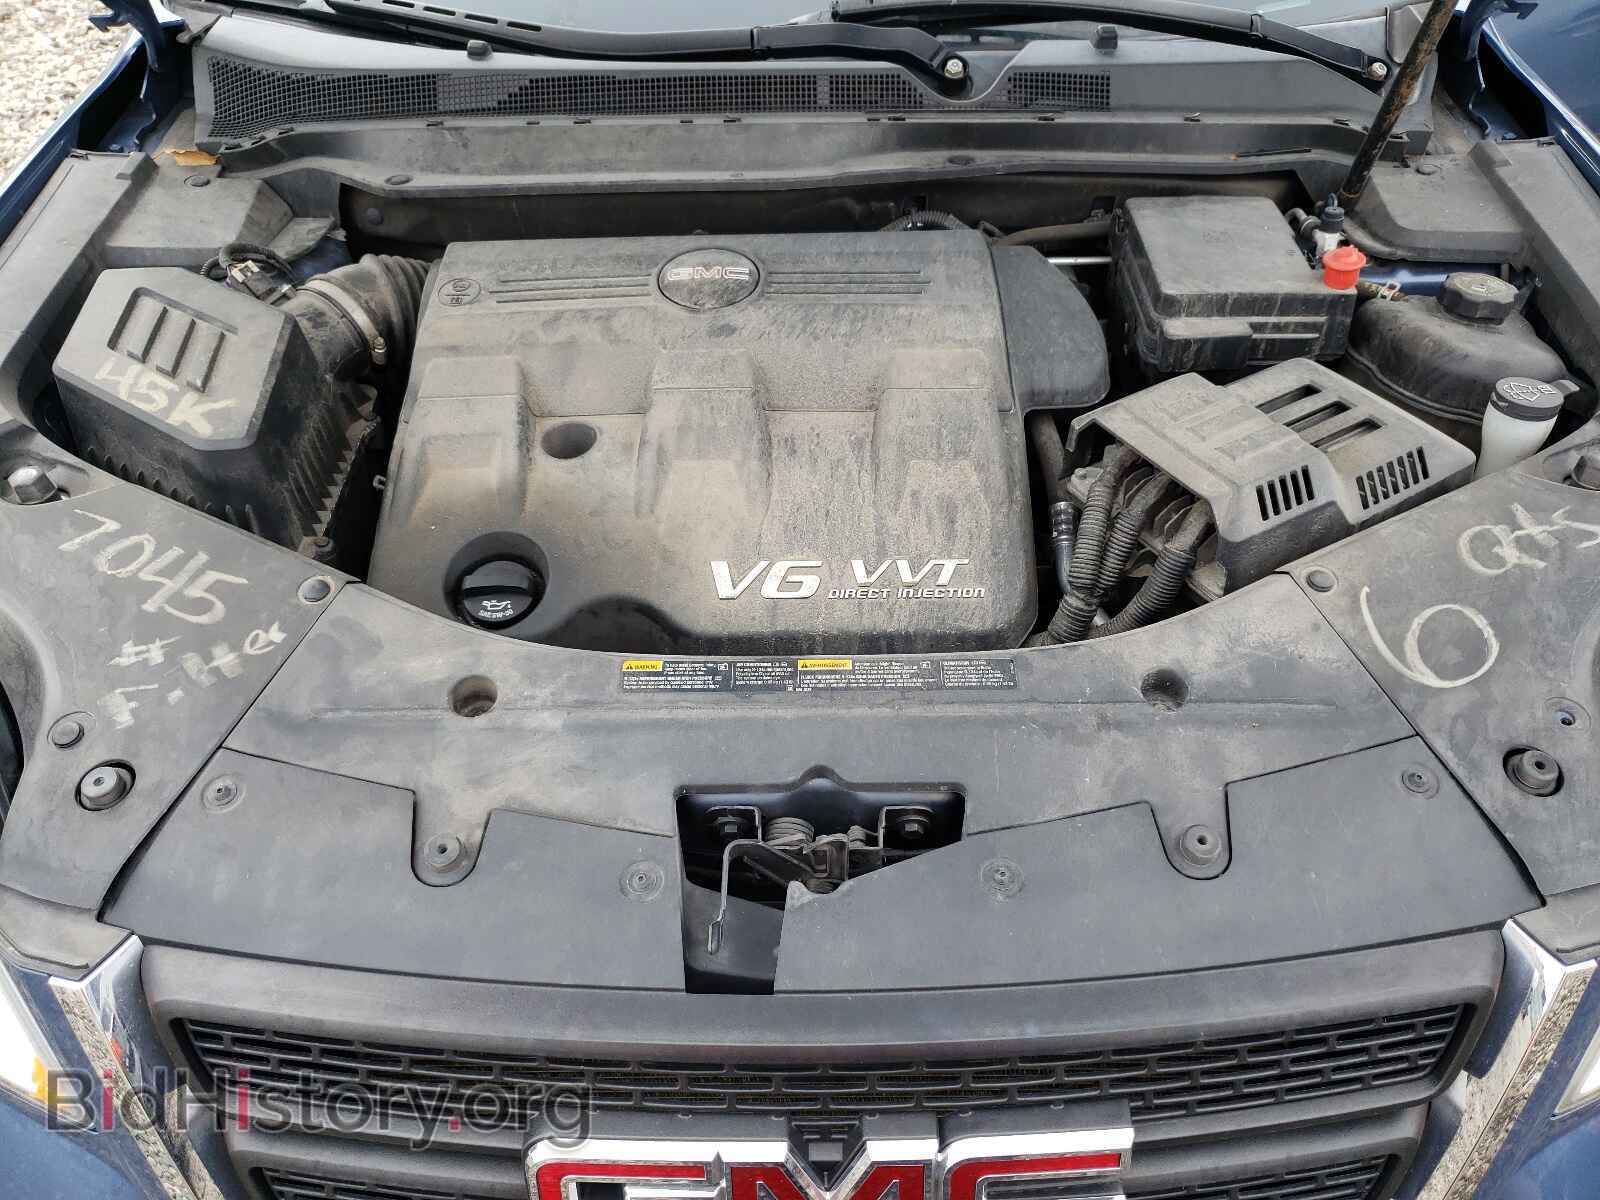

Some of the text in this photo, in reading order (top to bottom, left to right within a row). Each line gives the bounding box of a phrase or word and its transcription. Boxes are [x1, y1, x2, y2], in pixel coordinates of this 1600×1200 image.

[667, 265, 750, 281] GMC
[95, 355, 240, 434] 45K
[57, 508, 249, 625] 7045
[710, 559, 970, 600] V6 VVT
[828, 588, 890, 600] DIRECT
[1359, 585, 1500, 689] 6
